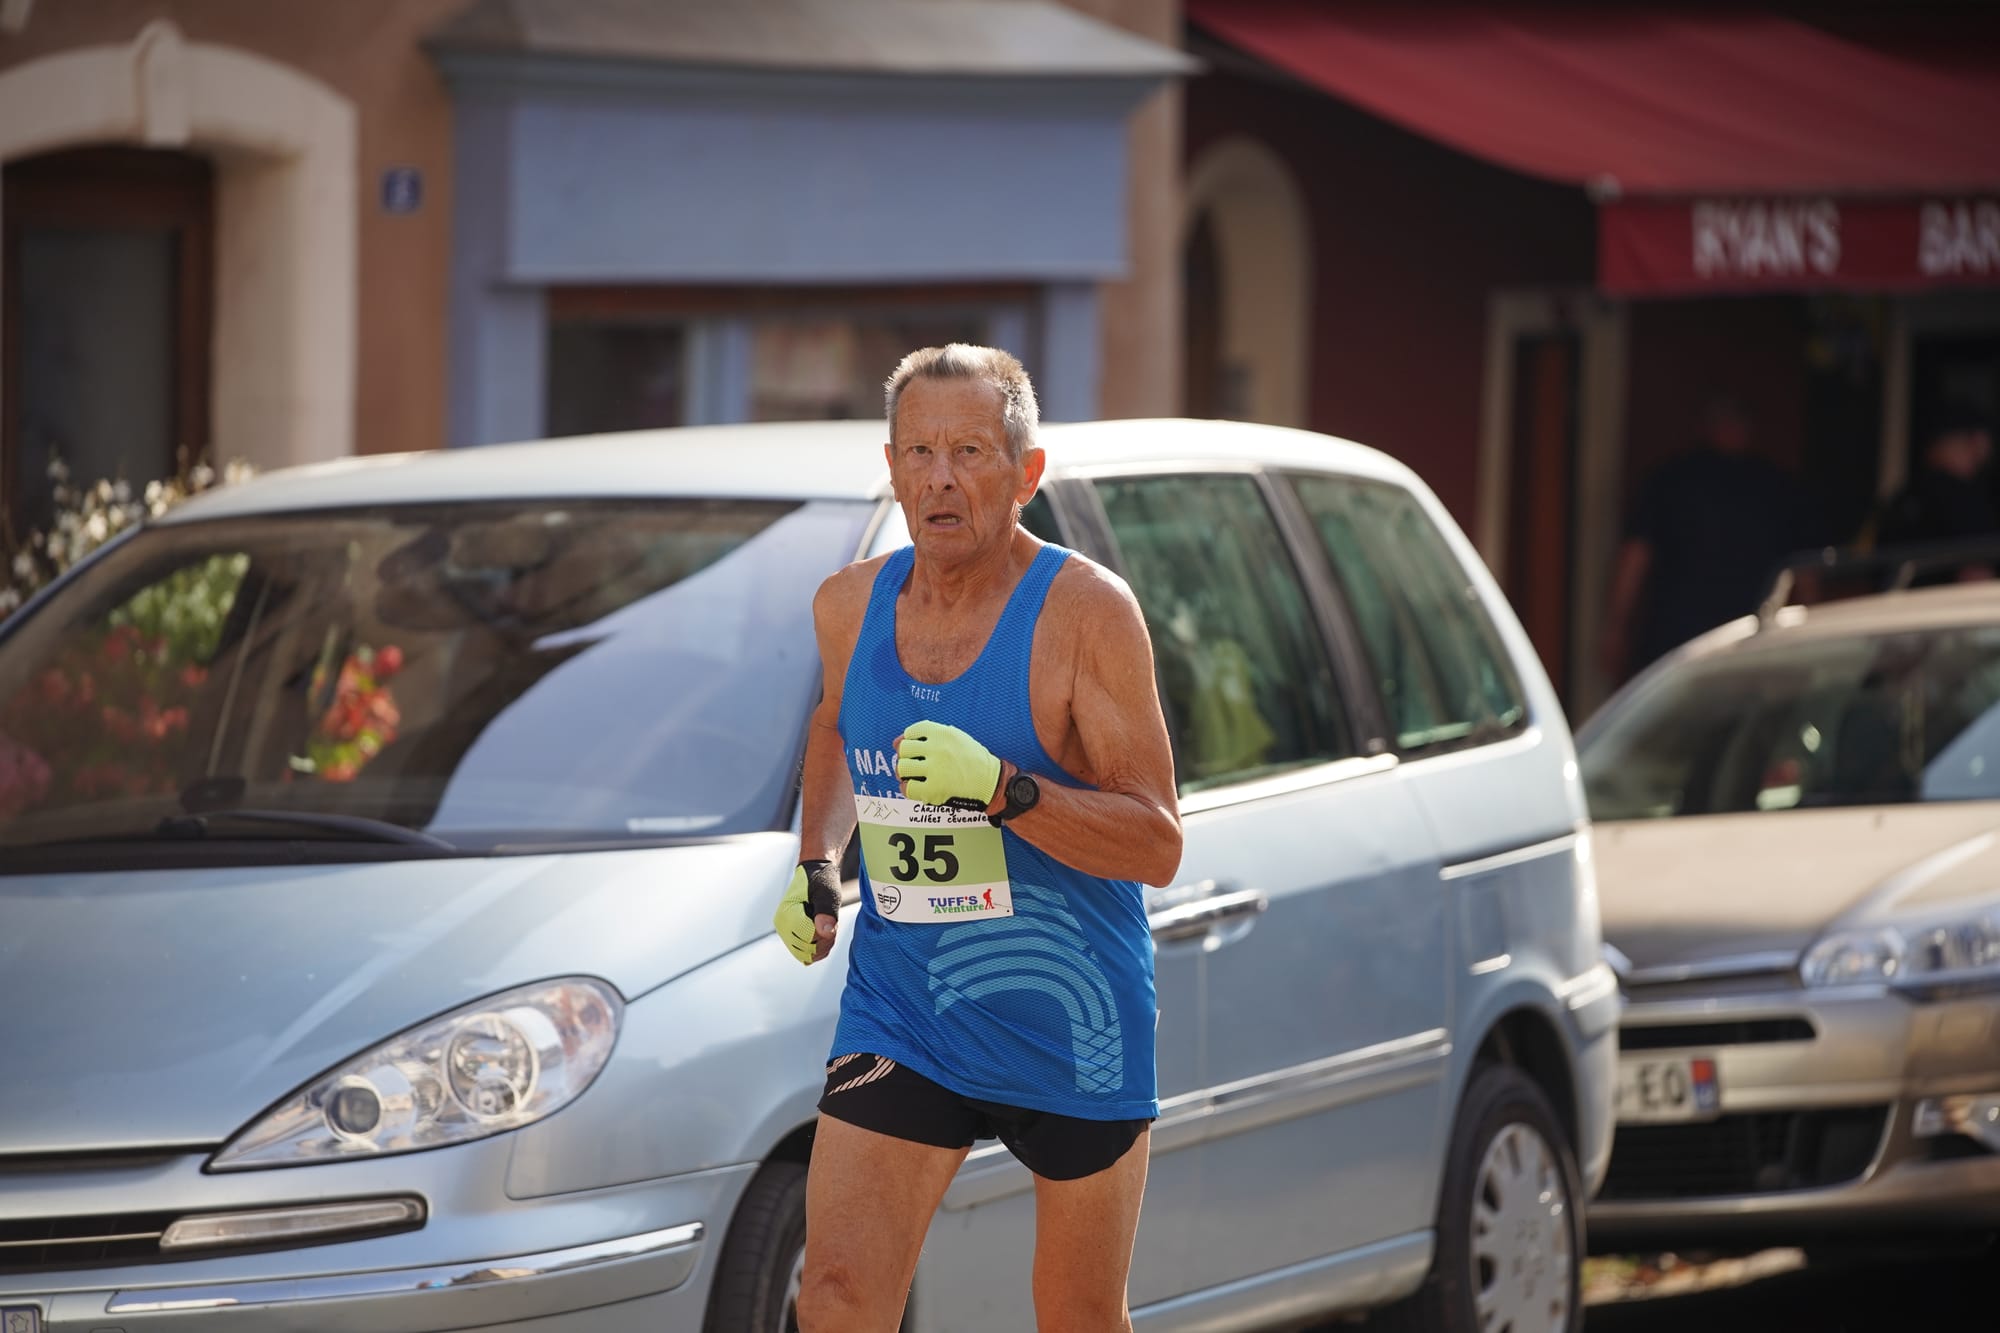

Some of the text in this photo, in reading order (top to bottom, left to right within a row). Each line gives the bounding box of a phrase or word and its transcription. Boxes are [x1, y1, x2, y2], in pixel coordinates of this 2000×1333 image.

[1692, 201, 1841, 276] RYAN'S
[911, 685, 940, 702] TACTIC
[913, 804, 962, 816] Challenge
[947, 814, 989, 824] cévenole
[888, 833, 959, 882] 35
[928, 896, 978, 907] TUFF'S
[933, 903, 984, 914] Aventure
